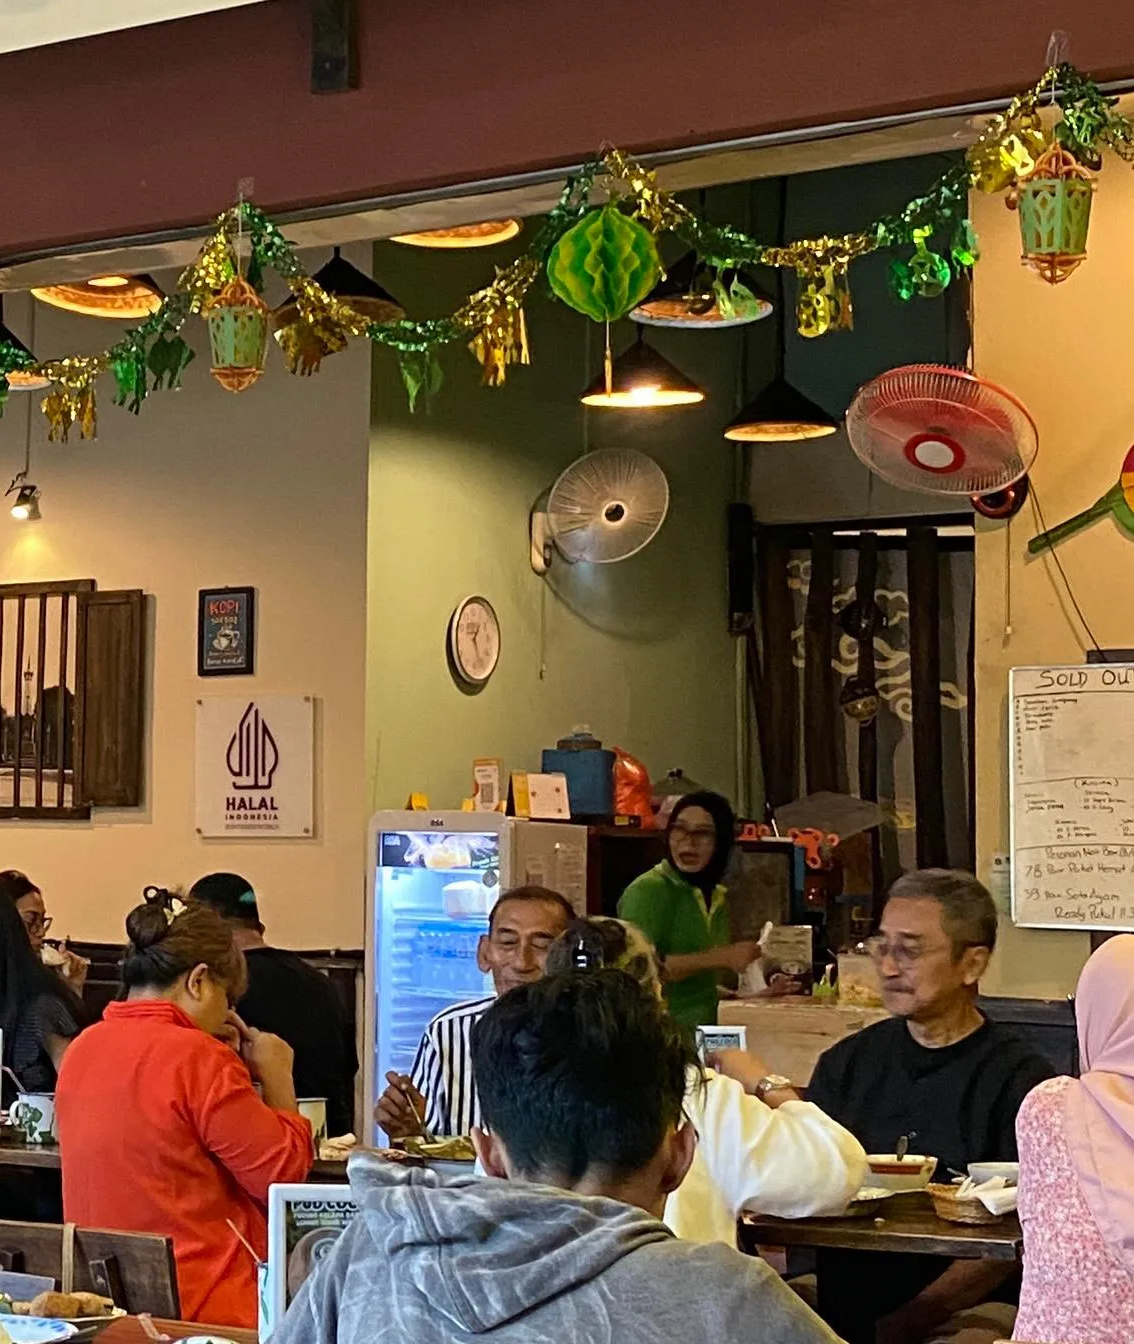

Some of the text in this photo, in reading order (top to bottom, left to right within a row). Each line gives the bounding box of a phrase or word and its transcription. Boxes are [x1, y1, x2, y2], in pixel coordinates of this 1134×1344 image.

[209, 599, 240, 616] KOPI
[1035, 670, 1088, 689] SOLD
[226, 796, 278, 811] HALAL
[225, 813, 278, 821] INDONESIA
[326, 1200, 358, 1210] COC
